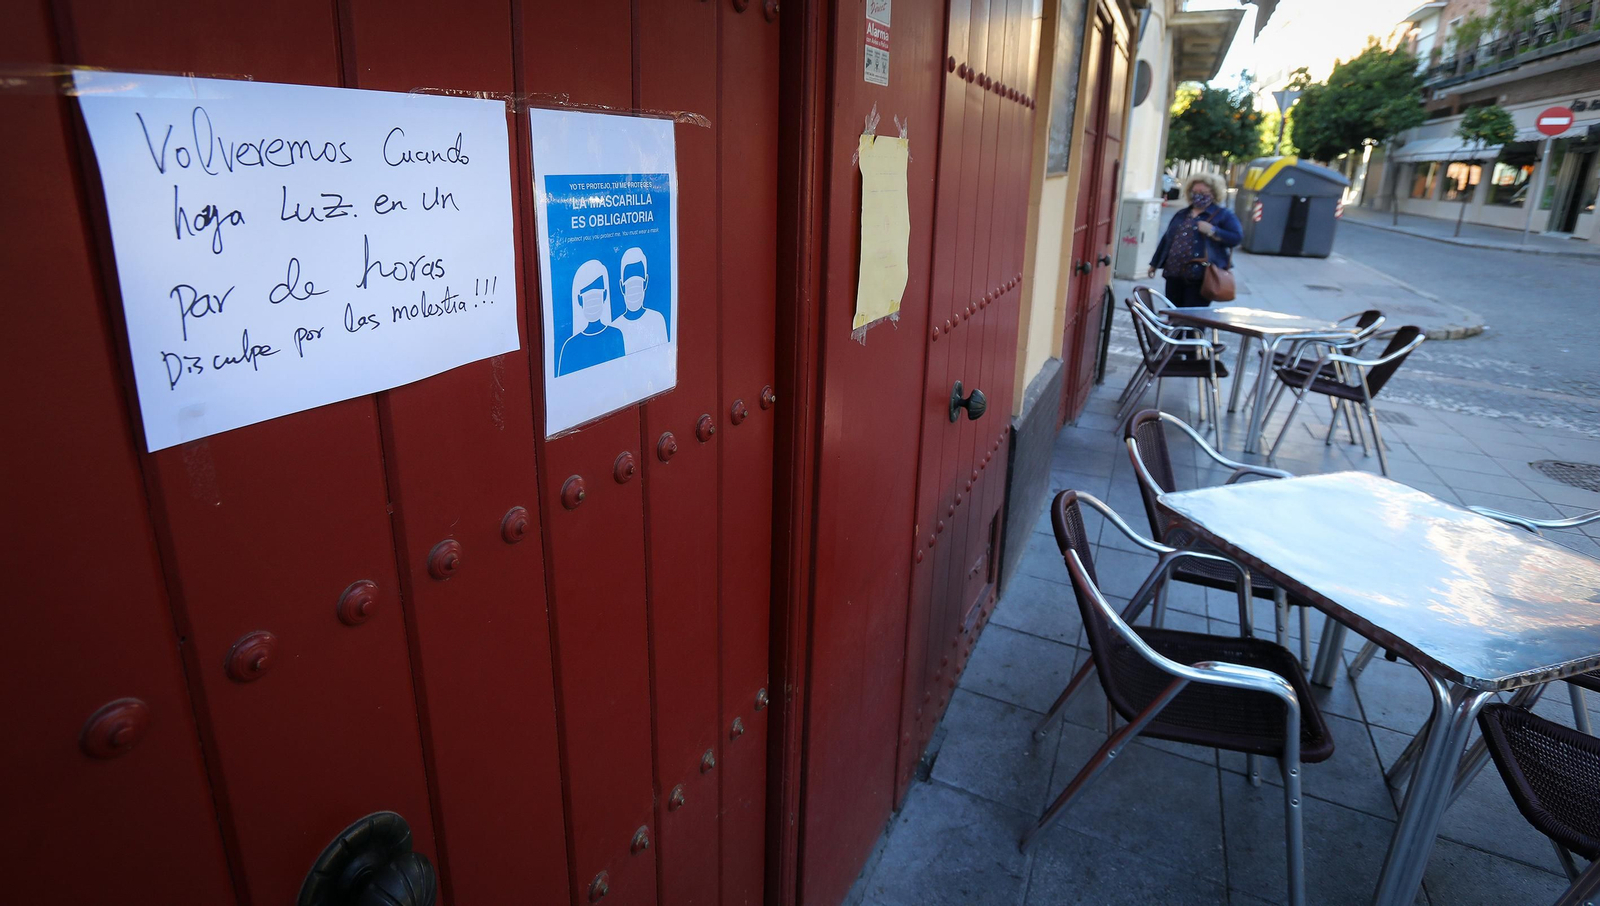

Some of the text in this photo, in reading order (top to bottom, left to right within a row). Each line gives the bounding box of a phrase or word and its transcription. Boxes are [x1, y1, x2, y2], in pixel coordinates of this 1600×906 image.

[866, 22, 889, 41] Alarma
[136, 106, 353, 176] Volveremos
[374, 194, 407, 215] en
[572, 193, 653, 209] LA MASCARILLA
[571, 210, 654, 229] ES OBLIGATORIA
[269, 258, 329, 305] de
[356, 234, 446, 290] horas
[294, 326, 325, 358] por
